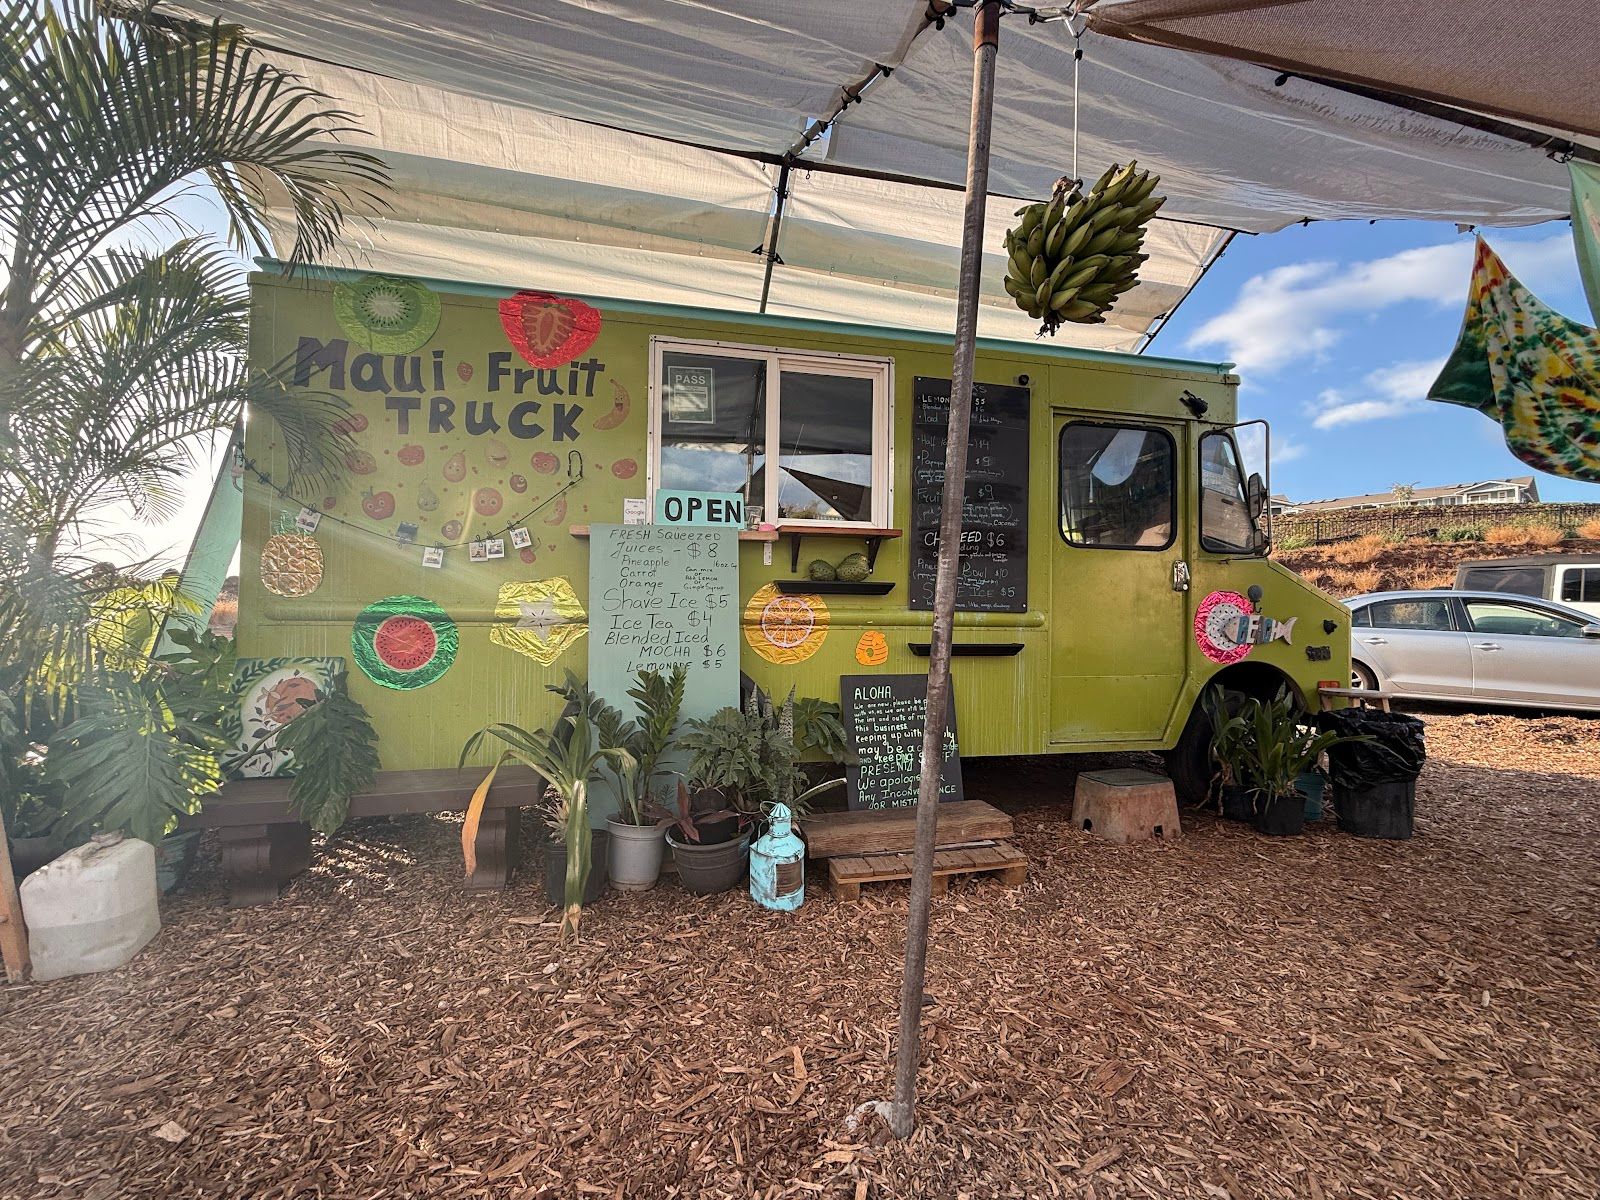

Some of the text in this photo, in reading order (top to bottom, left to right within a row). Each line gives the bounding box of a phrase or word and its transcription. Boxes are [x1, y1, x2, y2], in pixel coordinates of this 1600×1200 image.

[293, 336, 606, 397] Maui Fruit
[675, 374, 706, 385] PASS
[922, 394, 950, 403] LEMON
[385, 396, 585, 442] TRUCK
[664, 497, 741, 524] OPEN
[609, 529, 651, 540] FRESH
[960, 531, 982, 543] EED
[986, 531, 1005, 548] $6
[960, 543, 980, 554] ding
[621, 555, 670, 568] Pineapple
[917, 558, 938, 570] Pinea
[962, 562, 987, 578] Bowl
[620, 566, 657, 578] Carrot
[619, 578, 664, 596] Orange
[1000, 586, 1016, 598] $5
[602, 588, 731, 611] Shave Ice $5
[610, 610, 712, 630] Ice Tea $4
[605, 626, 709, 645] Blended Iced
[1236, 615, 1279, 644] BEACH
[639, 643, 727, 658] MOCHA $6
[893, 698, 911, 707] please
[907, 712, 915, 720] of
[873, 722, 909, 732] business
[890, 731, 902, 743] up
[903, 728, 922, 738] with
[858, 746, 880, 760] may
[886, 743, 904, 754] be
[907, 745, 915, 753] a
[857, 777, 876, 791] We
[859, 790, 876, 804] Any
[892, 798, 918, 807] MISTA
